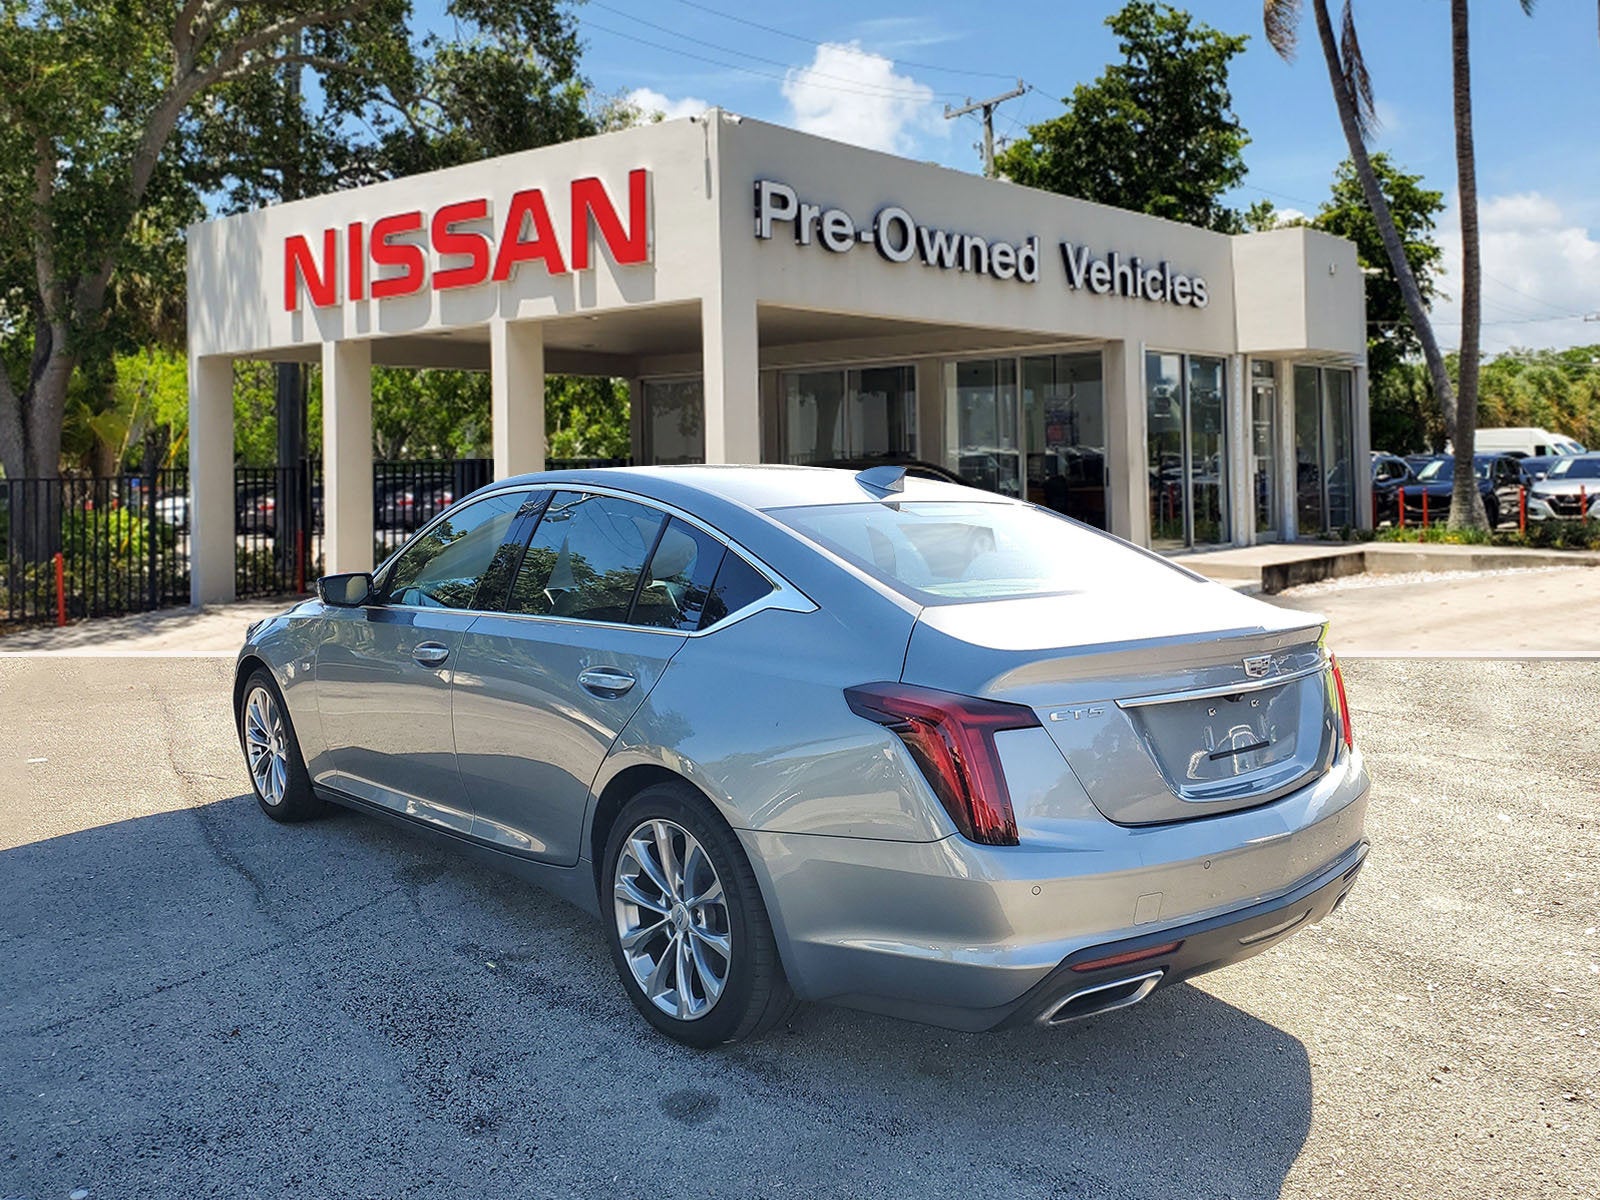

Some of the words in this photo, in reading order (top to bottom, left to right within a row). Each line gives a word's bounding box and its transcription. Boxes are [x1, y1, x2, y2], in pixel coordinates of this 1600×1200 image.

[284, 168, 648, 313] NISSAN
[754, 179, 1040, 283] Pre-Owned
[1059, 242, 1209, 309] Vehicles
